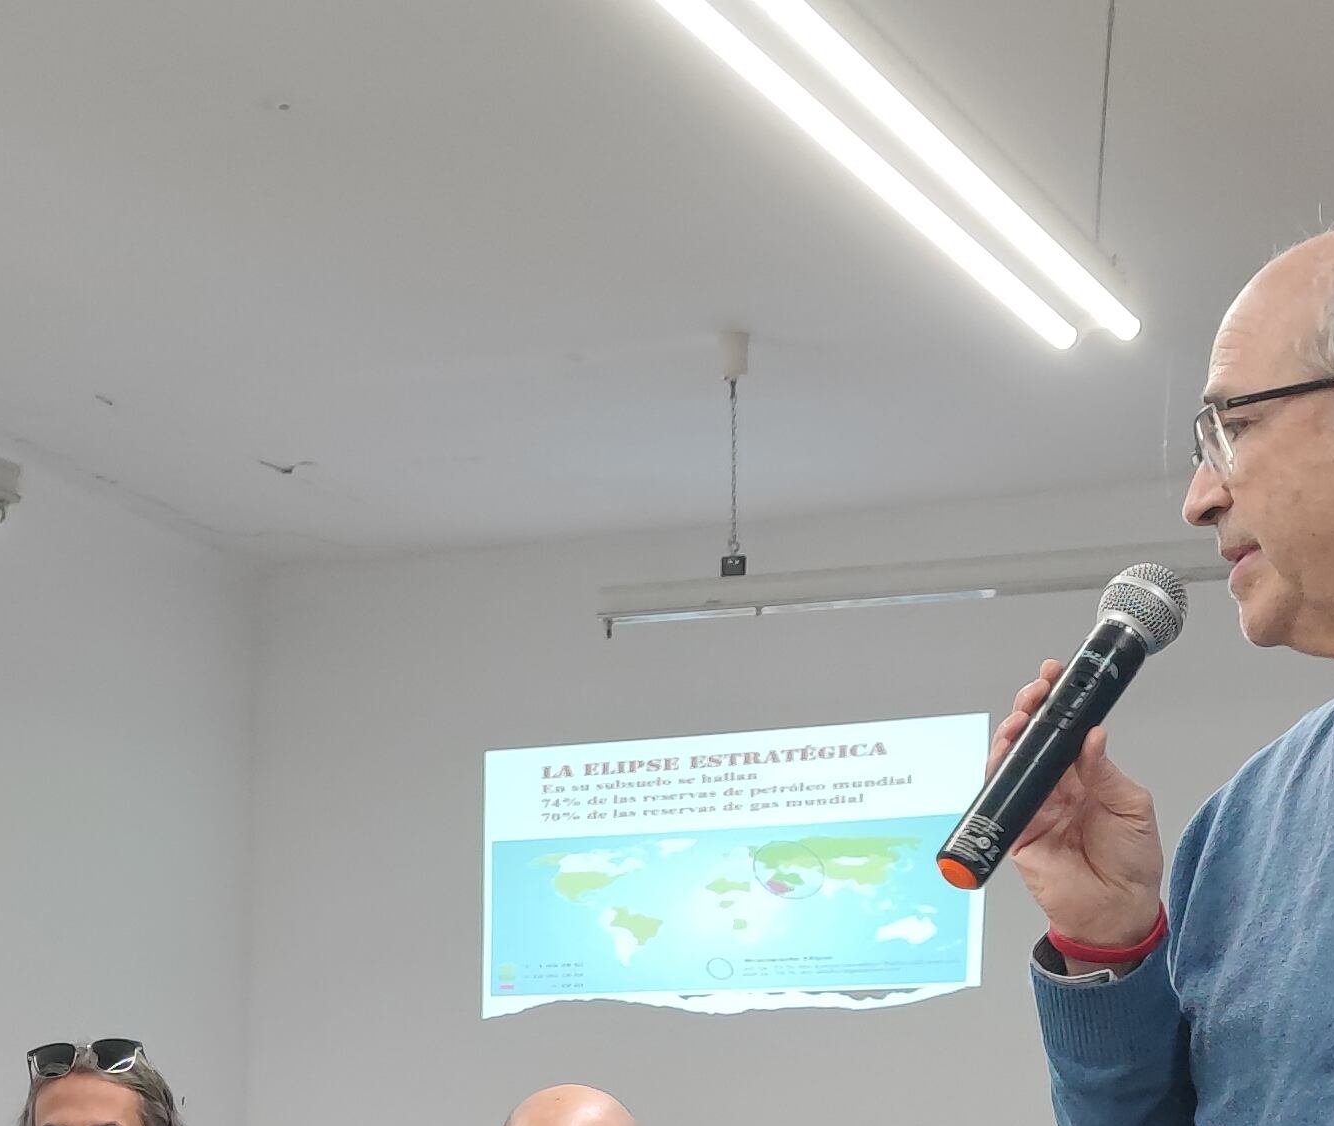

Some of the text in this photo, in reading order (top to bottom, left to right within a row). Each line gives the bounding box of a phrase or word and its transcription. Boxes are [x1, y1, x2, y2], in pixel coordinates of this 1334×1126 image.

[541, 742, 888, 779] LA ELIPSE ESTRATÉGICA
[541, 772, 758, 795] En su subsuelo se hallan
[587, 795, 608, 805] de
[613, 794, 637, 804] las
[643, 790, 717, 802] reservas
[723, 787, 744, 797] de
[750, 782, 826, 797] petróleo
[832, 774, 913, 790] mundial
[587, 810, 608, 820] de
[613, 808, 637, 818] las
[643, 805, 717, 817] reservas
[723, 801, 744, 811] de
[750, 801, 780, 811] gas
[786, 793, 865, 807] mundial
